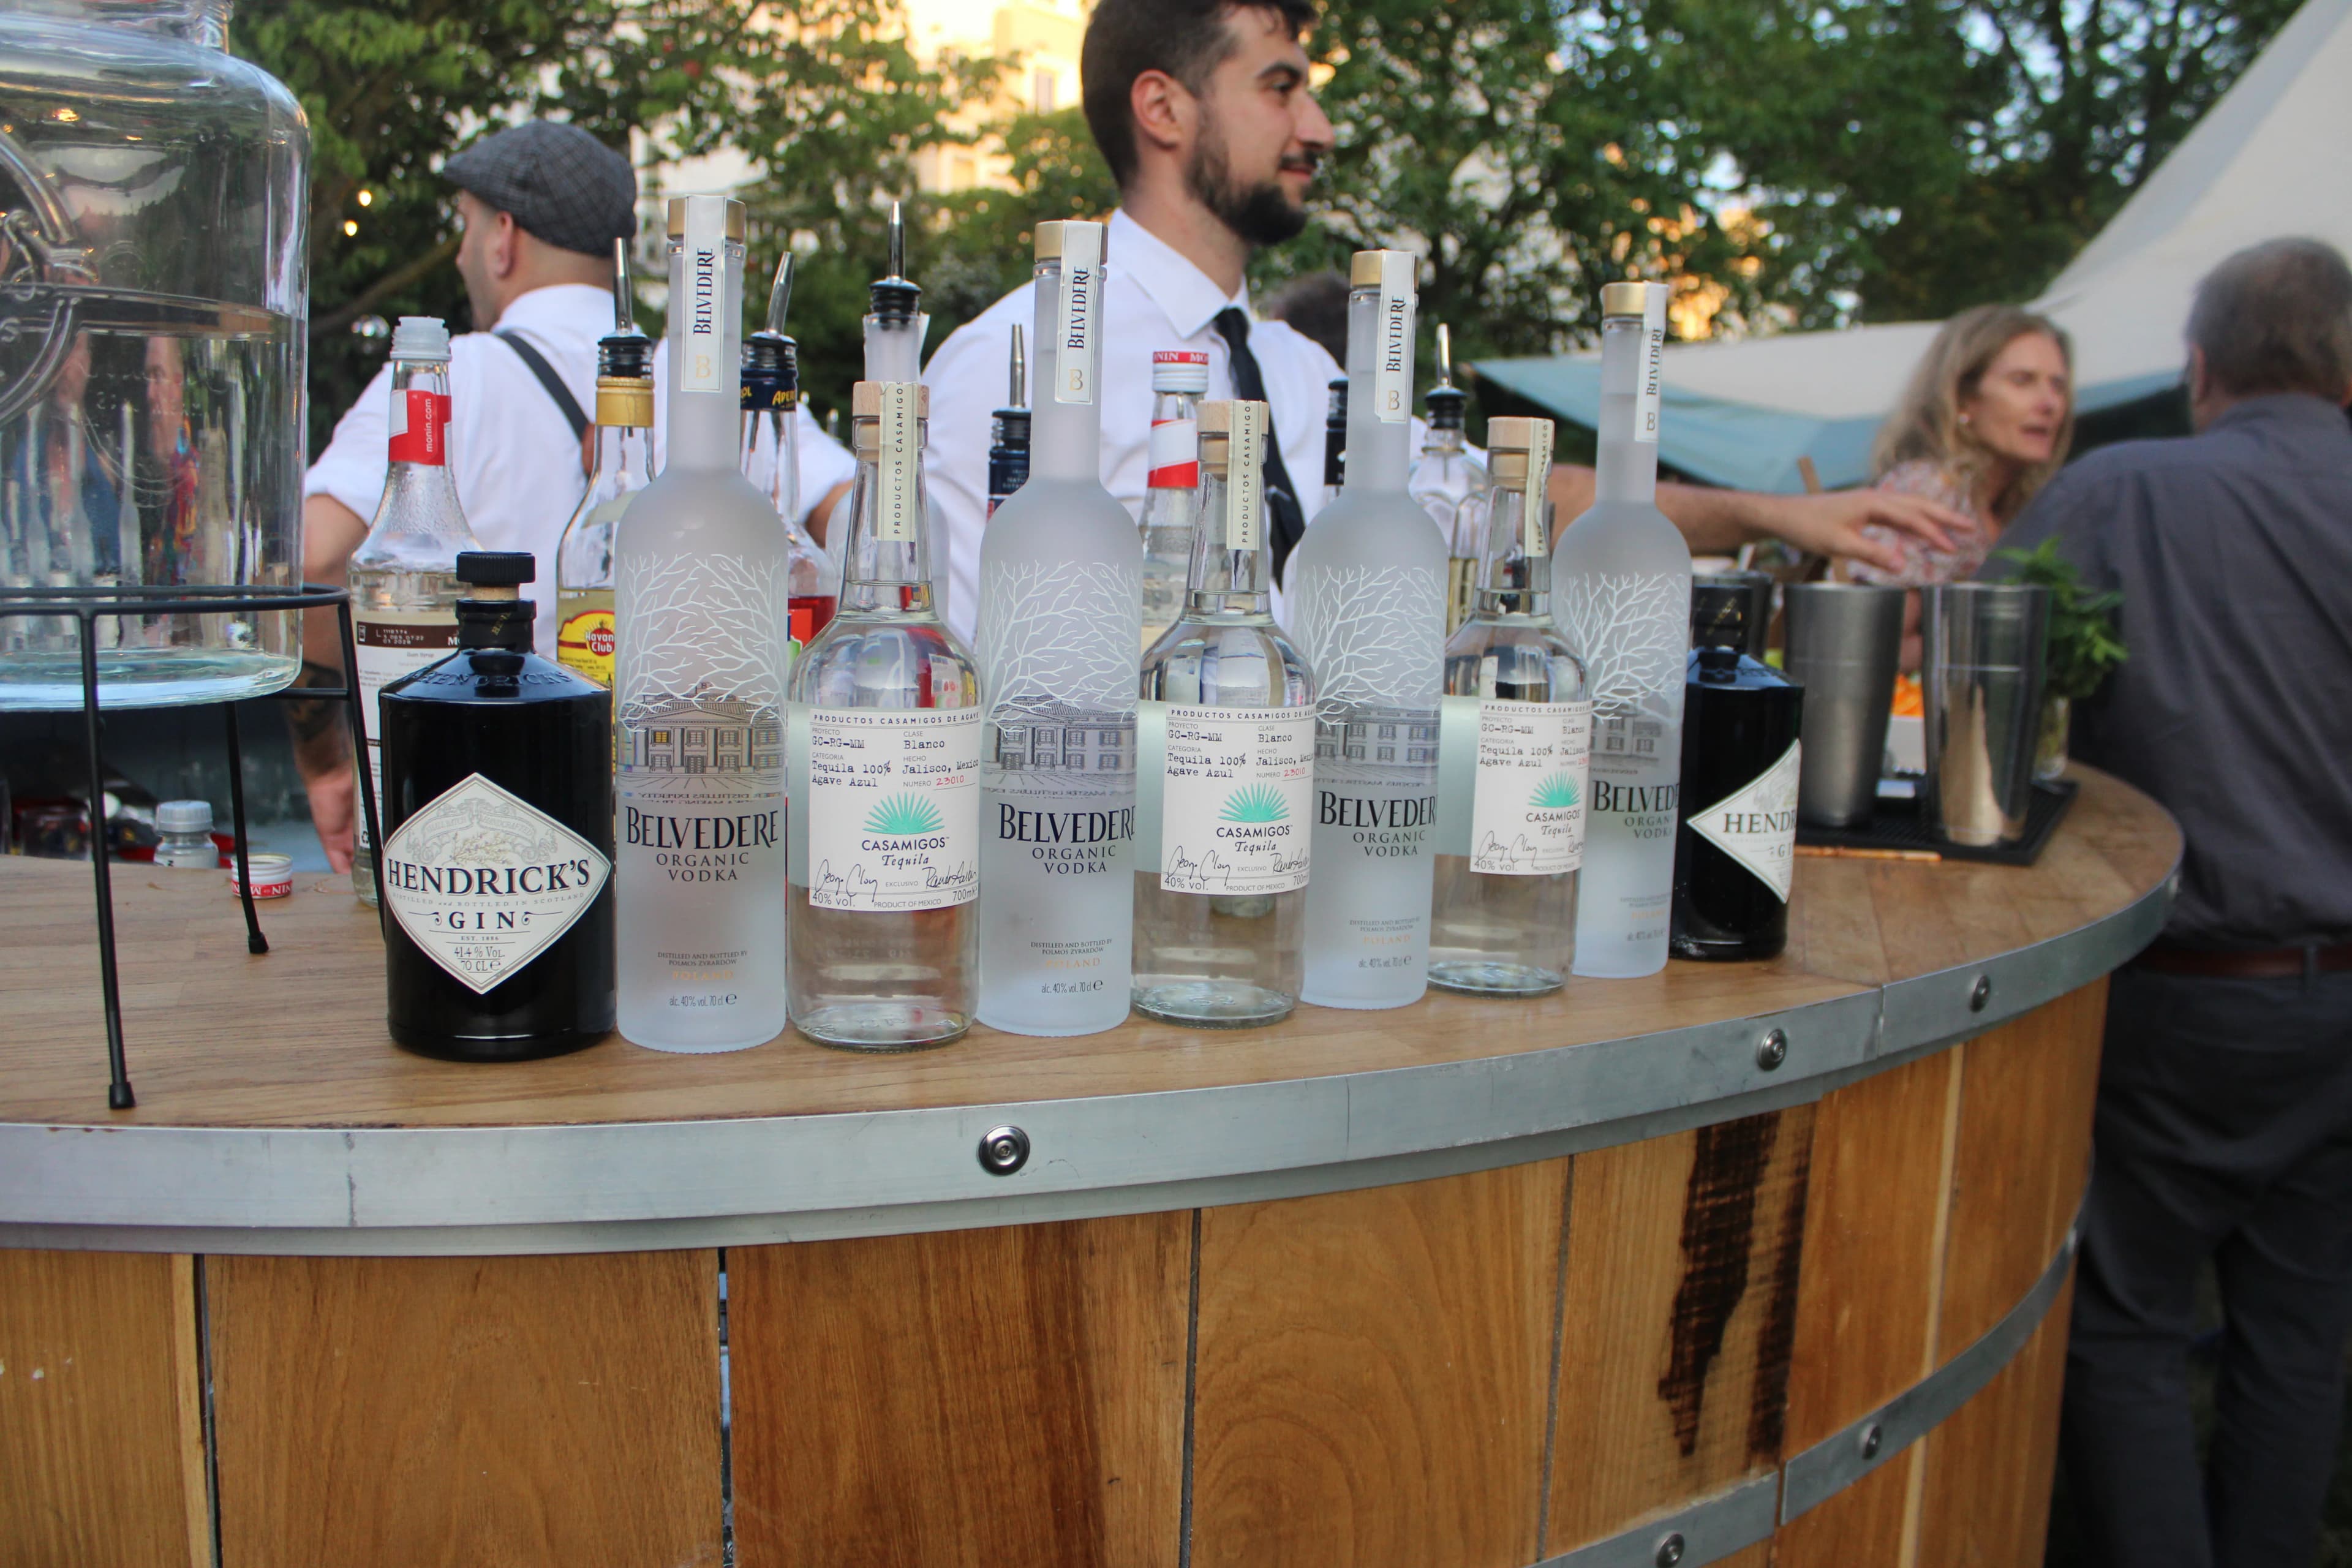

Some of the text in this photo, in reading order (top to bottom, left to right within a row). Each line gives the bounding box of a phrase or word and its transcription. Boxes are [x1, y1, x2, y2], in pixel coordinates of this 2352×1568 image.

[693, 248, 715, 335] BELVEDERE
[1068, 266, 1090, 350] BELVEDERE
[1386, 295, 1406, 372] BELVEDERE
[424, 398, 432, 452] monin.com
[592, 642, 612, 653] Club
[814, 714, 873, 723] PRODUCTOS
[961, 712, 979, 721] AGAVE
[1171, 709, 1231, 718] PRODUCTOS
[812, 727, 840, 736] PROYECTO
[1258, 734, 1292, 742] Blanco
[903, 740, 945, 749] Blanco
[1480, 744, 1553, 758] Tequila 100%
[1167, 752, 1246, 768] Tequila 100%
[1256, 756, 1296, 766] Jalisco,
[1480, 757, 1512, 767] Agave
[812, 760, 891, 776] Tequila 100%
[902, 759, 979, 774] Jalisco, Mexico
[1167, 766, 1234, 778] Agave Azul
[1284, 767, 1305, 777] 23010
[812, 774, 878, 787] Agave Azul
[1526, 810, 1580, 822] CASAMIGOS
[625, 806, 778, 849] BELVEDERE
[1541, 824, 1572, 838] Tequila
[1353, 830, 1425, 843] ORGANIC
[1032, 845, 1116, 860] ORGANIC
[1235, 840, 1276, 855] Tequila
[1364, 845, 1418, 857] VODKA
[656, 852, 748, 867] ORGANIC
[881, 854, 929, 870] Tequila
[1474, 861, 1495, 870] 40%
[1044, 862, 1107, 874] VODKA
[668, 869, 738, 881] VODKA
[1164, 877, 1185, 888] 40%
[393, 892, 433, 905] DISTILLED
[534, 892, 584, 905] SCOTLAND
[812, 893, 832, 905] 40%
[449, 911, 515, 929] GIN
[461, 960, 488, 971] 70 CL
[1046, 957, 1101, 968] POLAND
[673, 970, 734, 980] POLAND
[1041, 982, 1052, 993] alc.
[1054, 982, 1067, 993] 40%
[1079, 982, 1086, 992] 70
[681, 995, 696, 1006] 40%
[710, 995, 717, 1006] 70
